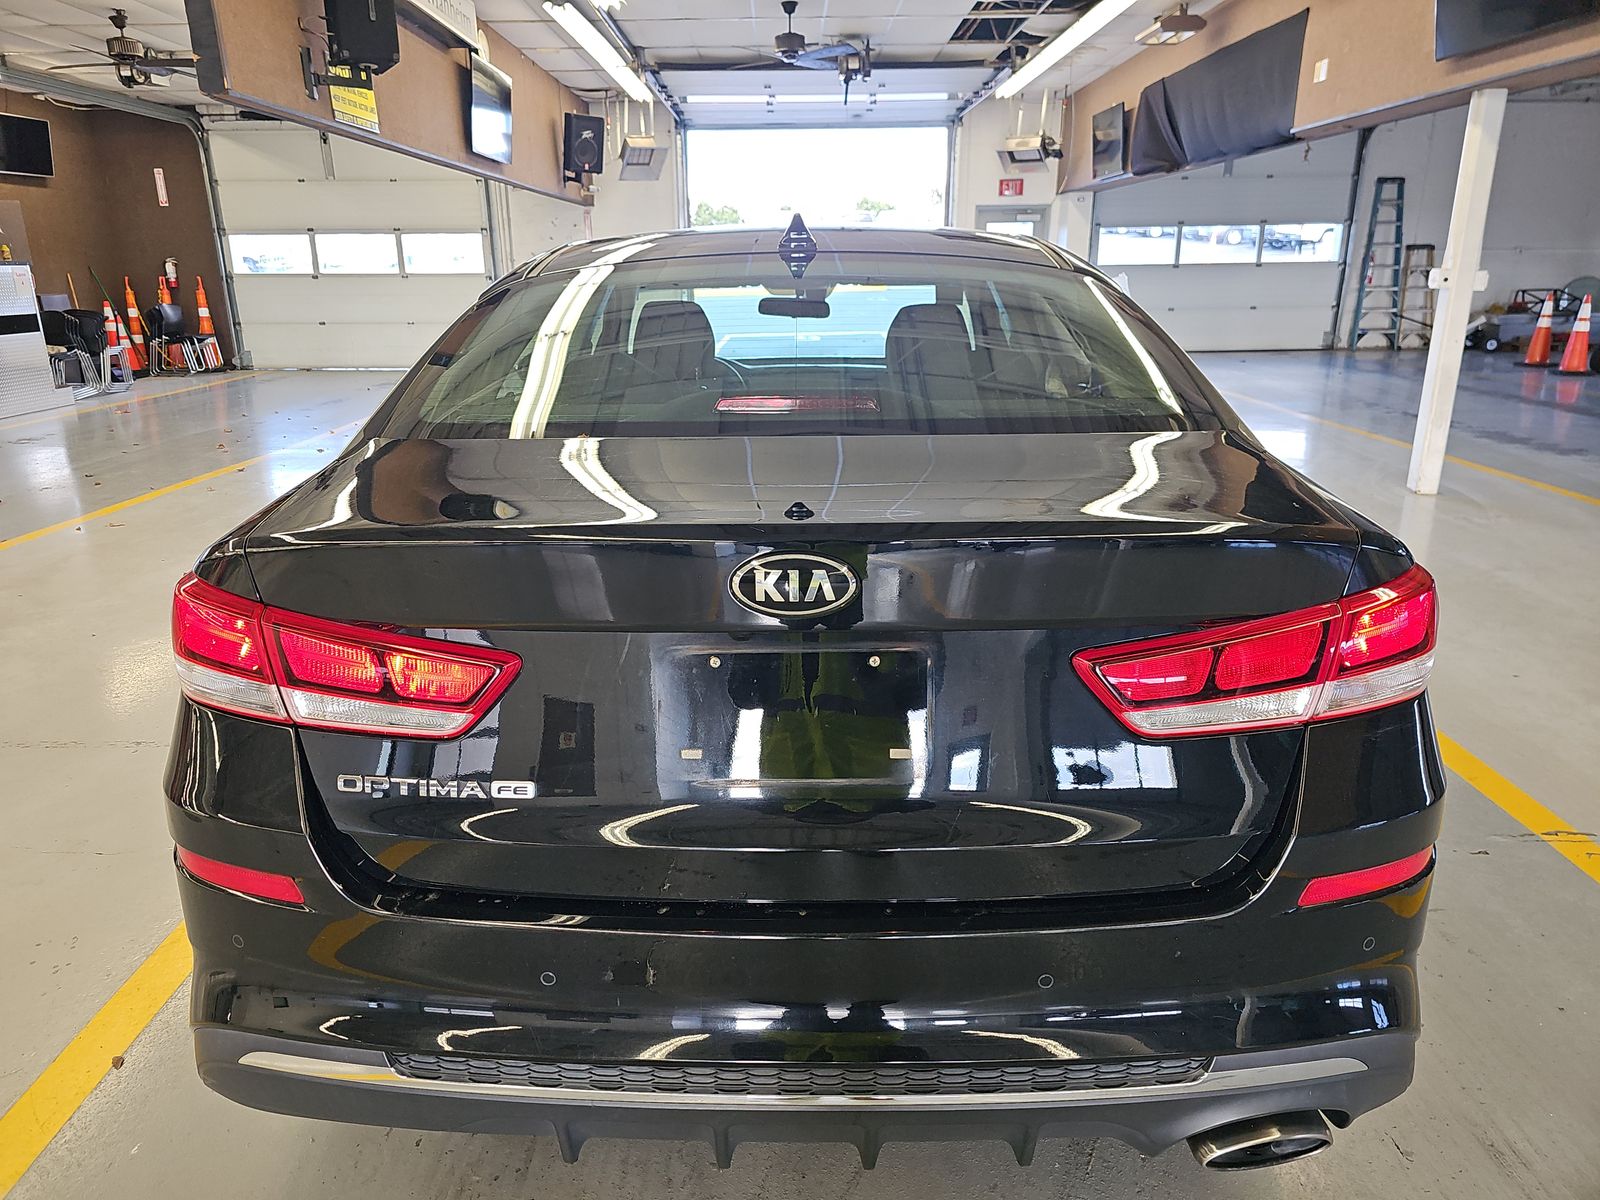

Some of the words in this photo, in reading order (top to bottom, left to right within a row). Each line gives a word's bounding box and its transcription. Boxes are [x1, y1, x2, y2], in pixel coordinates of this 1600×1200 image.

[753, 569, 837, 602] KIA
[336, 774, 488, 799] OPTIMA
[495, 784, 530, 797] FE
